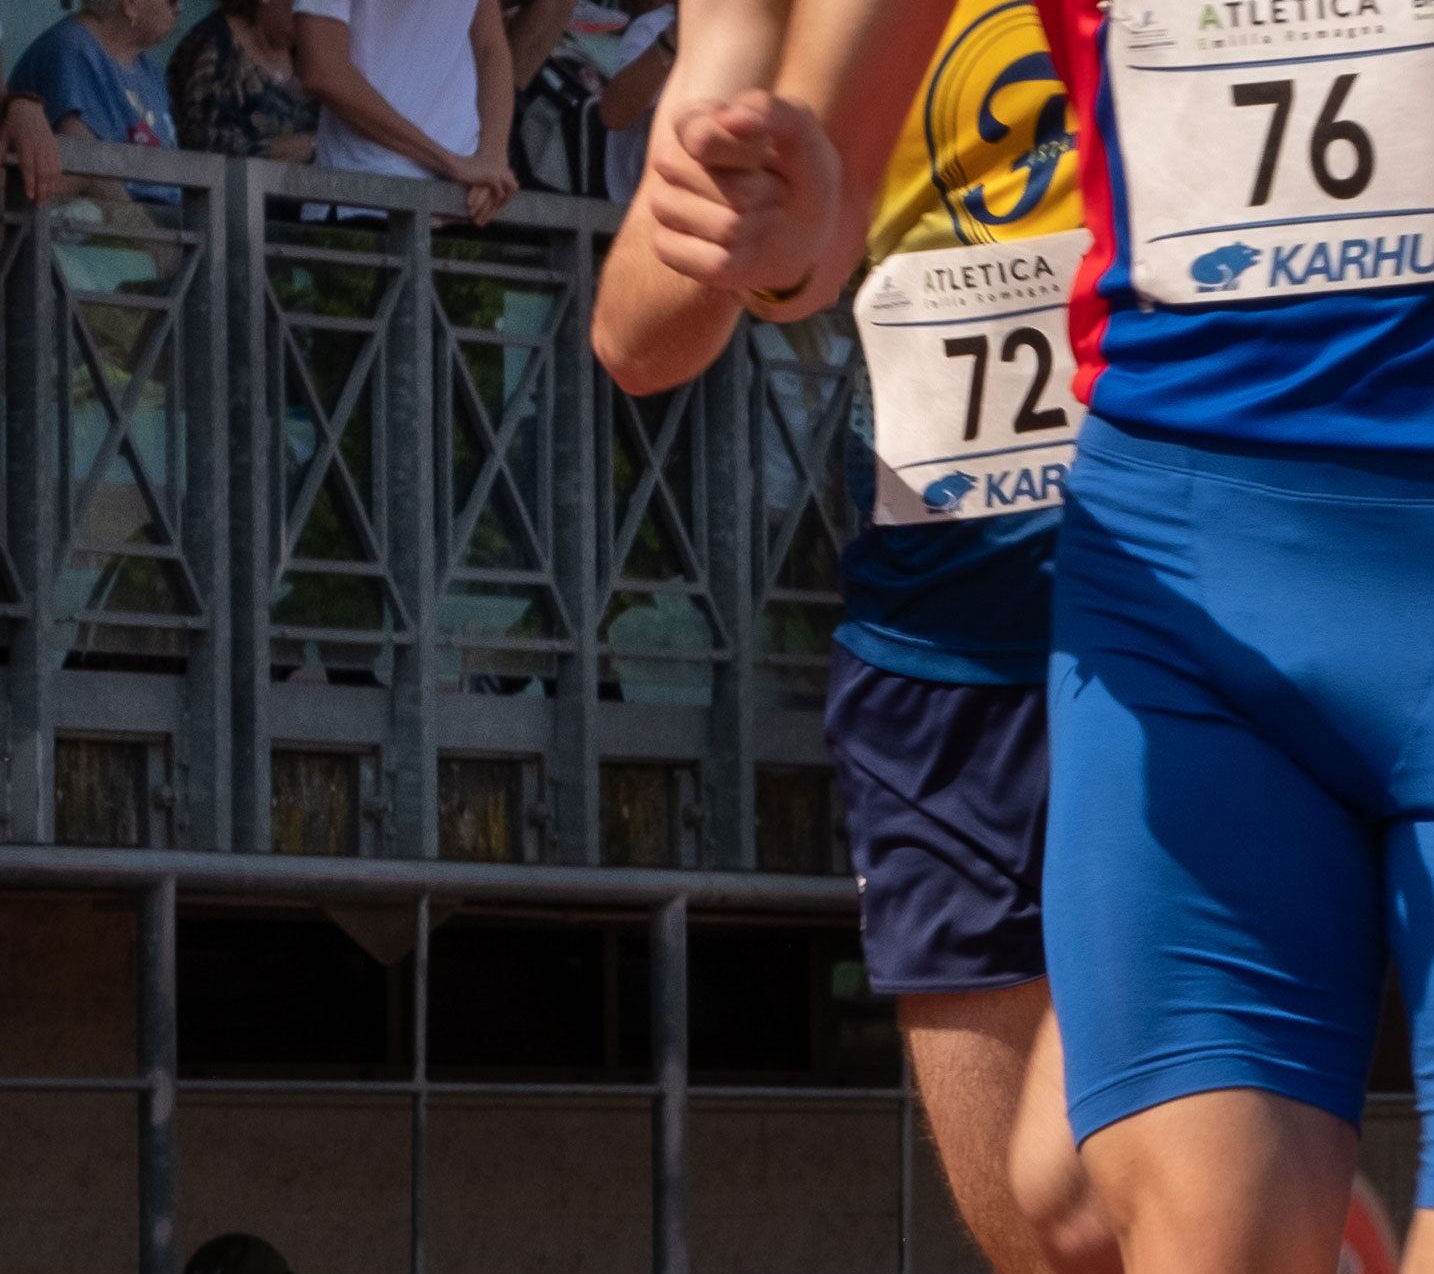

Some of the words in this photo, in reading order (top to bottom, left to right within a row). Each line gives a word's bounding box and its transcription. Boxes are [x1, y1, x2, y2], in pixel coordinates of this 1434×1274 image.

[1230, 73, 1376, 208] 76
[922, 253, 1056, 293] ATLETICA
[942, 326, 1069, 442] 72
[985, 464, 1068, 509] KAR
